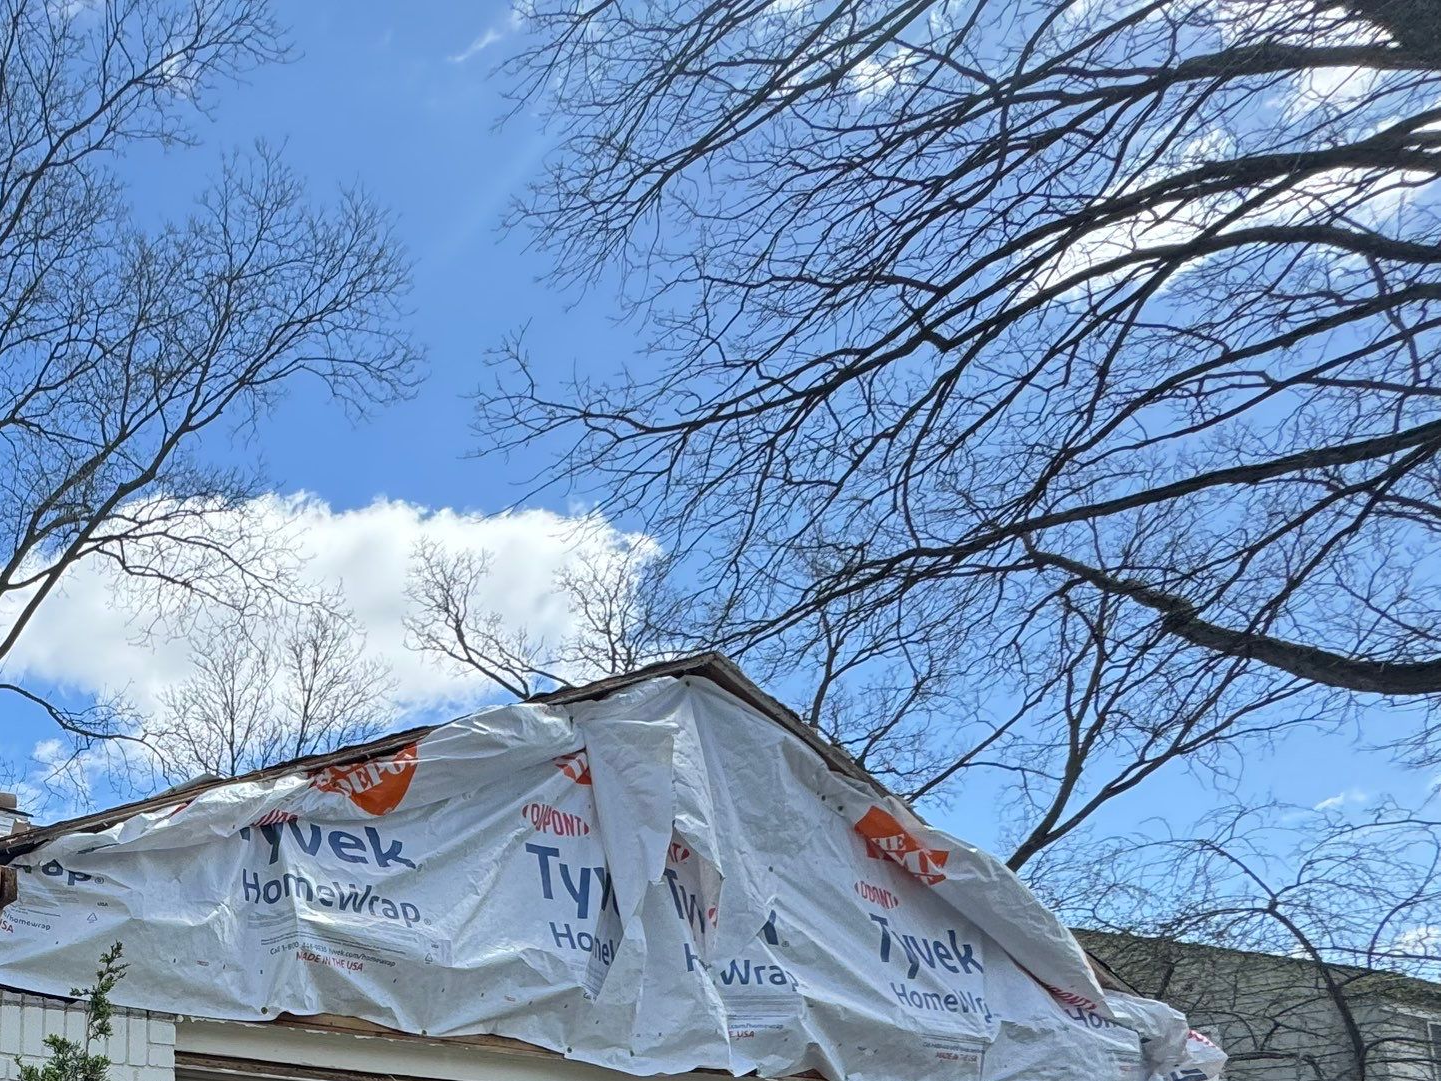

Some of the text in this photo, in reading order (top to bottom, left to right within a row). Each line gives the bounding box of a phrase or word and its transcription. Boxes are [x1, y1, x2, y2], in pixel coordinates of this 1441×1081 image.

[240, 822, 417, 870] yvek
[243, 868, 420, 928] HomeWrap
[346, 960, 364, 972] USA
